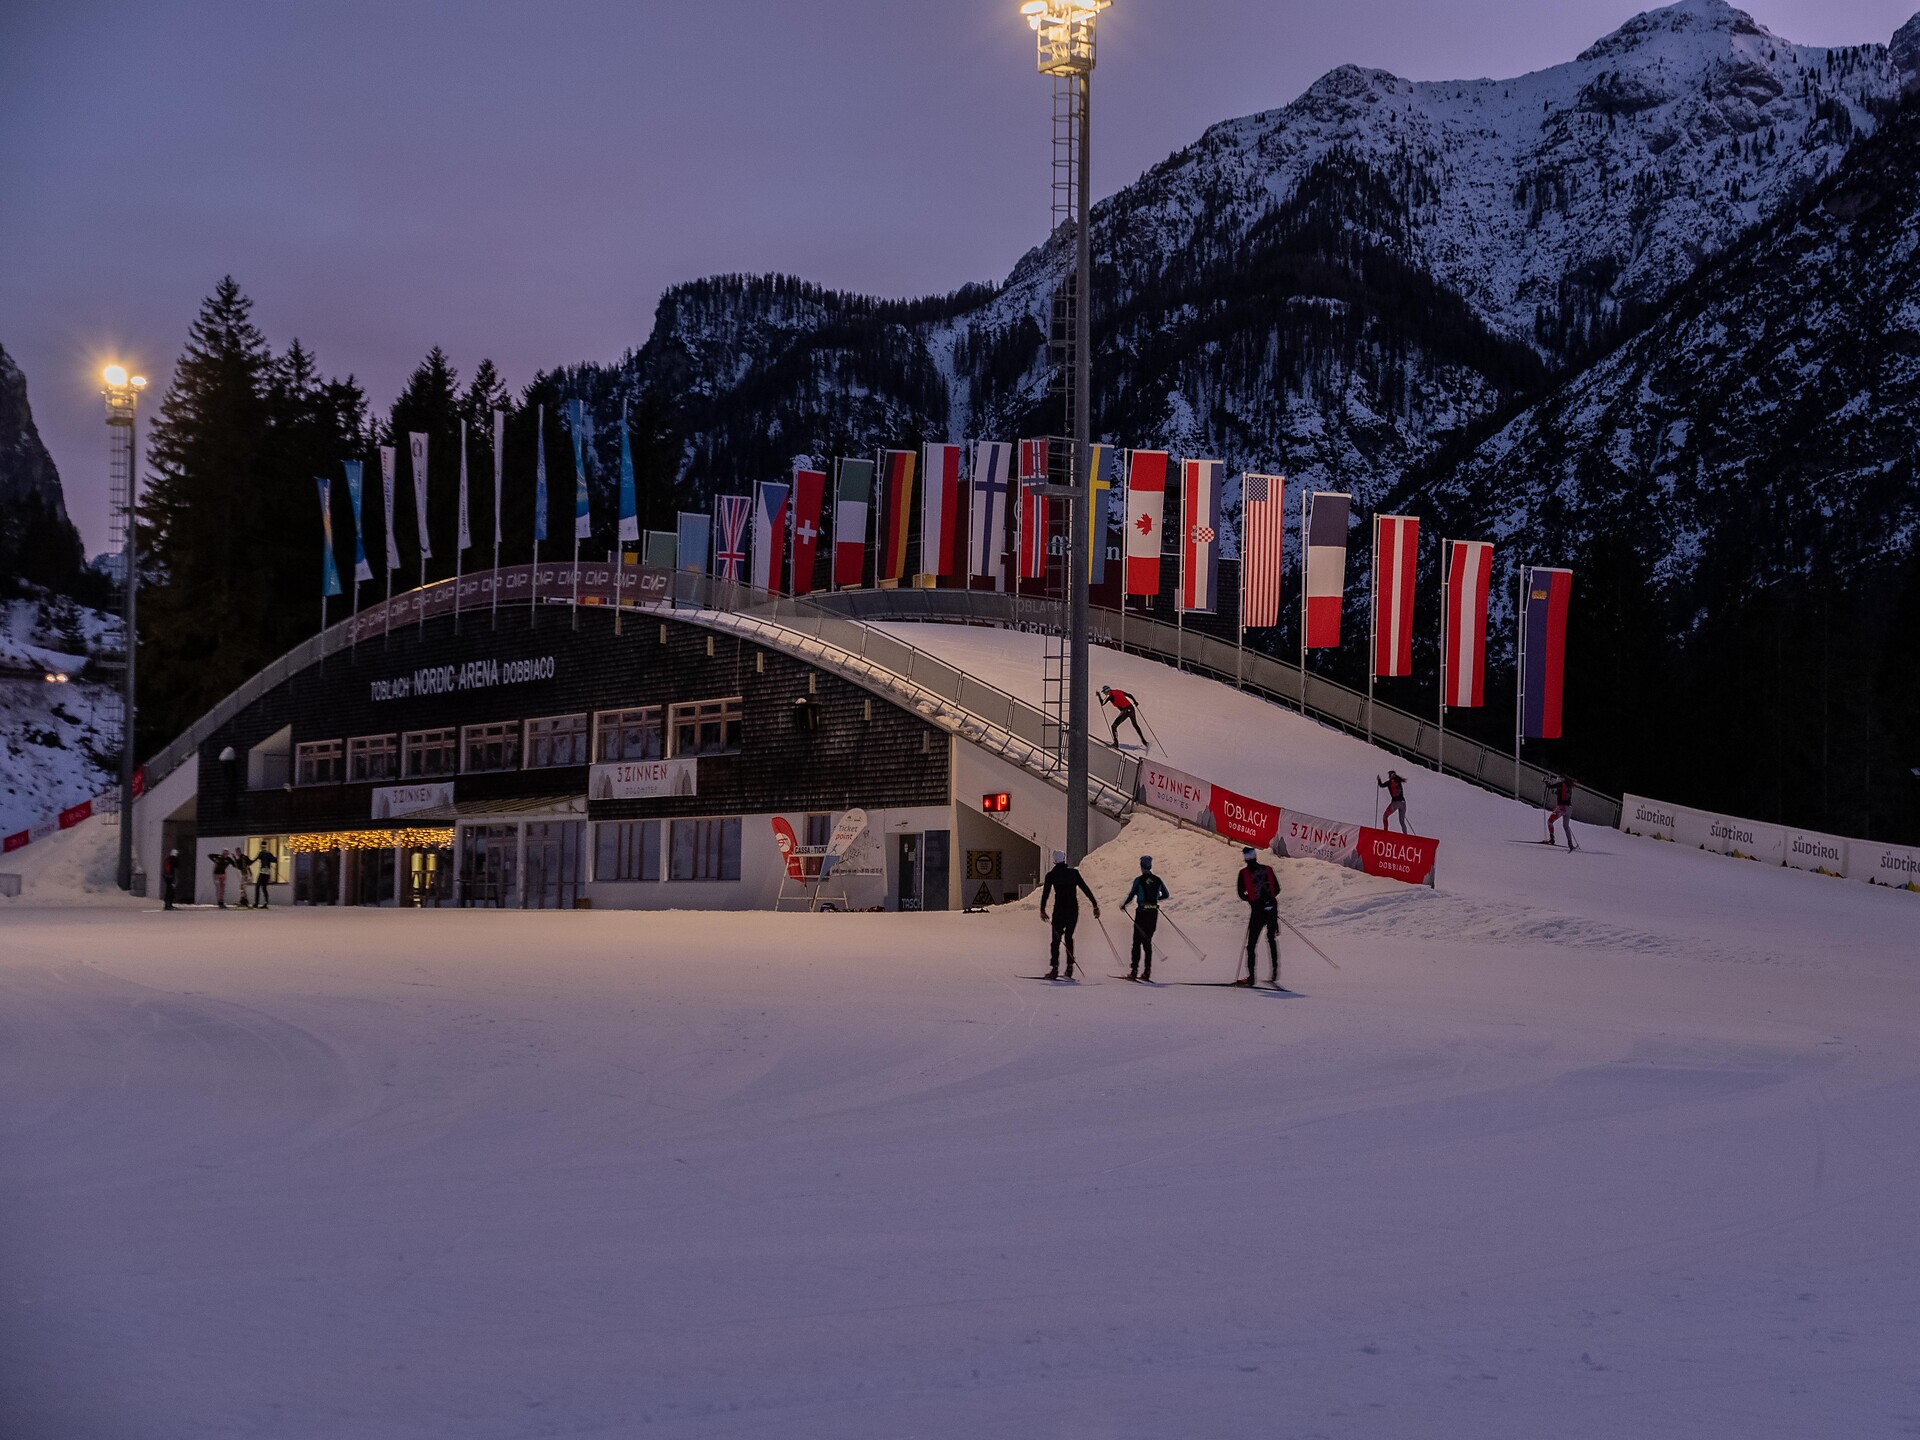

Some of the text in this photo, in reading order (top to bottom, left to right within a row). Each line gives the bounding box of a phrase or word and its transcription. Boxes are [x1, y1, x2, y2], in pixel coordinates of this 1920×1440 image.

[506, 573, 528, 588] CMP
[585, 569, 609, 585] CMP
[641, 574, 667, 591] CMP
[370, 656, 555, 701] TOBLACH NORDIC ARENA DOBBIACO
[1223, 800, 1268, 828] TOBLACH
[1228, 821, 1256, 836] DOBBIACO
[1372, 840, 1421, 864] TOBLACH
[1378, 860, 1411, 873] DOBBIACO
